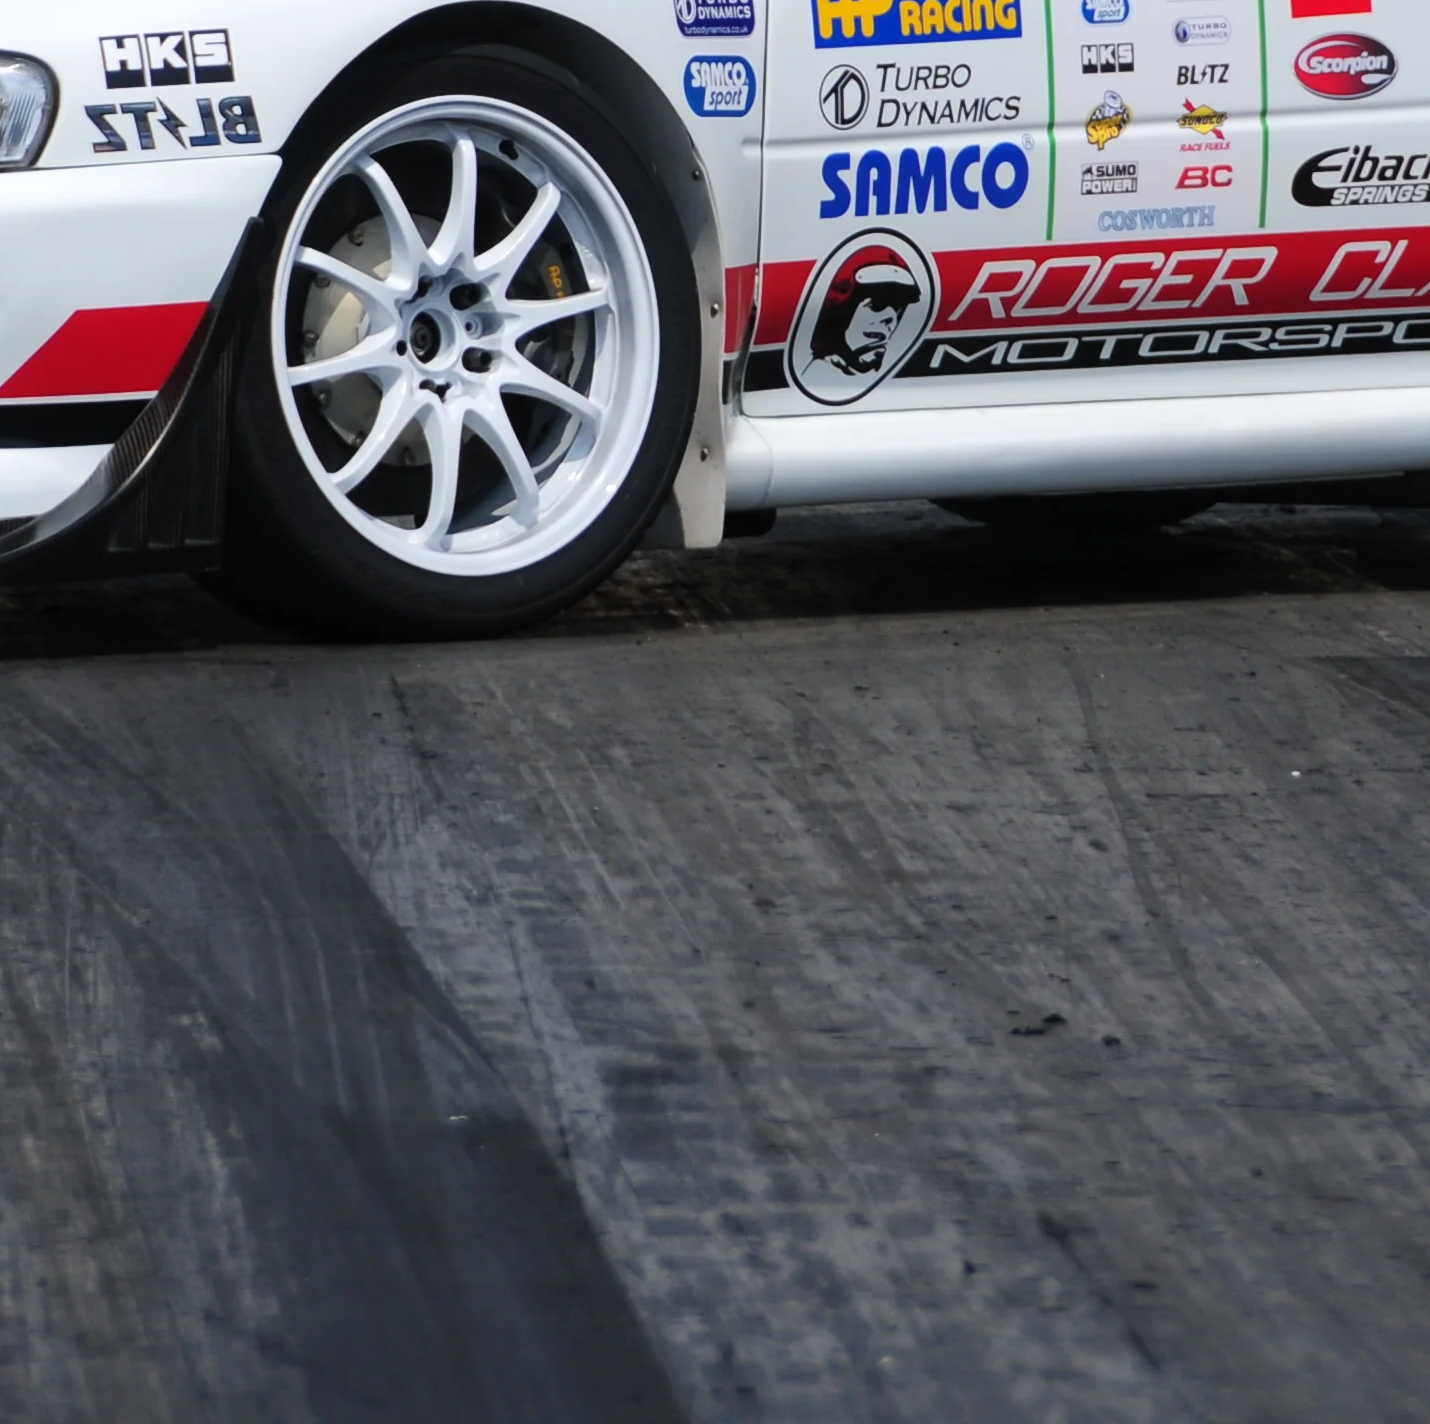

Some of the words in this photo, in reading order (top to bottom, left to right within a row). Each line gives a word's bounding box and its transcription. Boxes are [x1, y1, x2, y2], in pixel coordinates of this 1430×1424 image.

[697, 5, 751, 19] DYNAMICS
[1098, 9, 1121, 20] sport
[1191, 22, 1227, 30] TURBO
[99, 29, 235, 89] HKS
[1081, 43, 1134, 74] HKS
[1308, 51, 1388, 75] Scorpion
[690, 62, 747, 88] SAMCO
[876, 63, 972, 92] TURBO
[709, 87, 743, 110] sport
[876, 96, 1021, 128] DYNAMICS
[1177, 113, 1226, 126] SUNOCO
[1179, 143, 1202, 152] RACE
[1204, 141, 1231, 151] FUELS
[819, 142, 1030, 219] SAMCO
[1096, 164, 1136, 178] SUMO
[1175, 165, 1233, 190] BC
[1082, 178, 1132, 194] POWER
[1330, 184, 1429, 206] SPRINGS
[1098, 205, 1216, 232] COSWORTH
[947, 246, 1278, 321] ROGER
